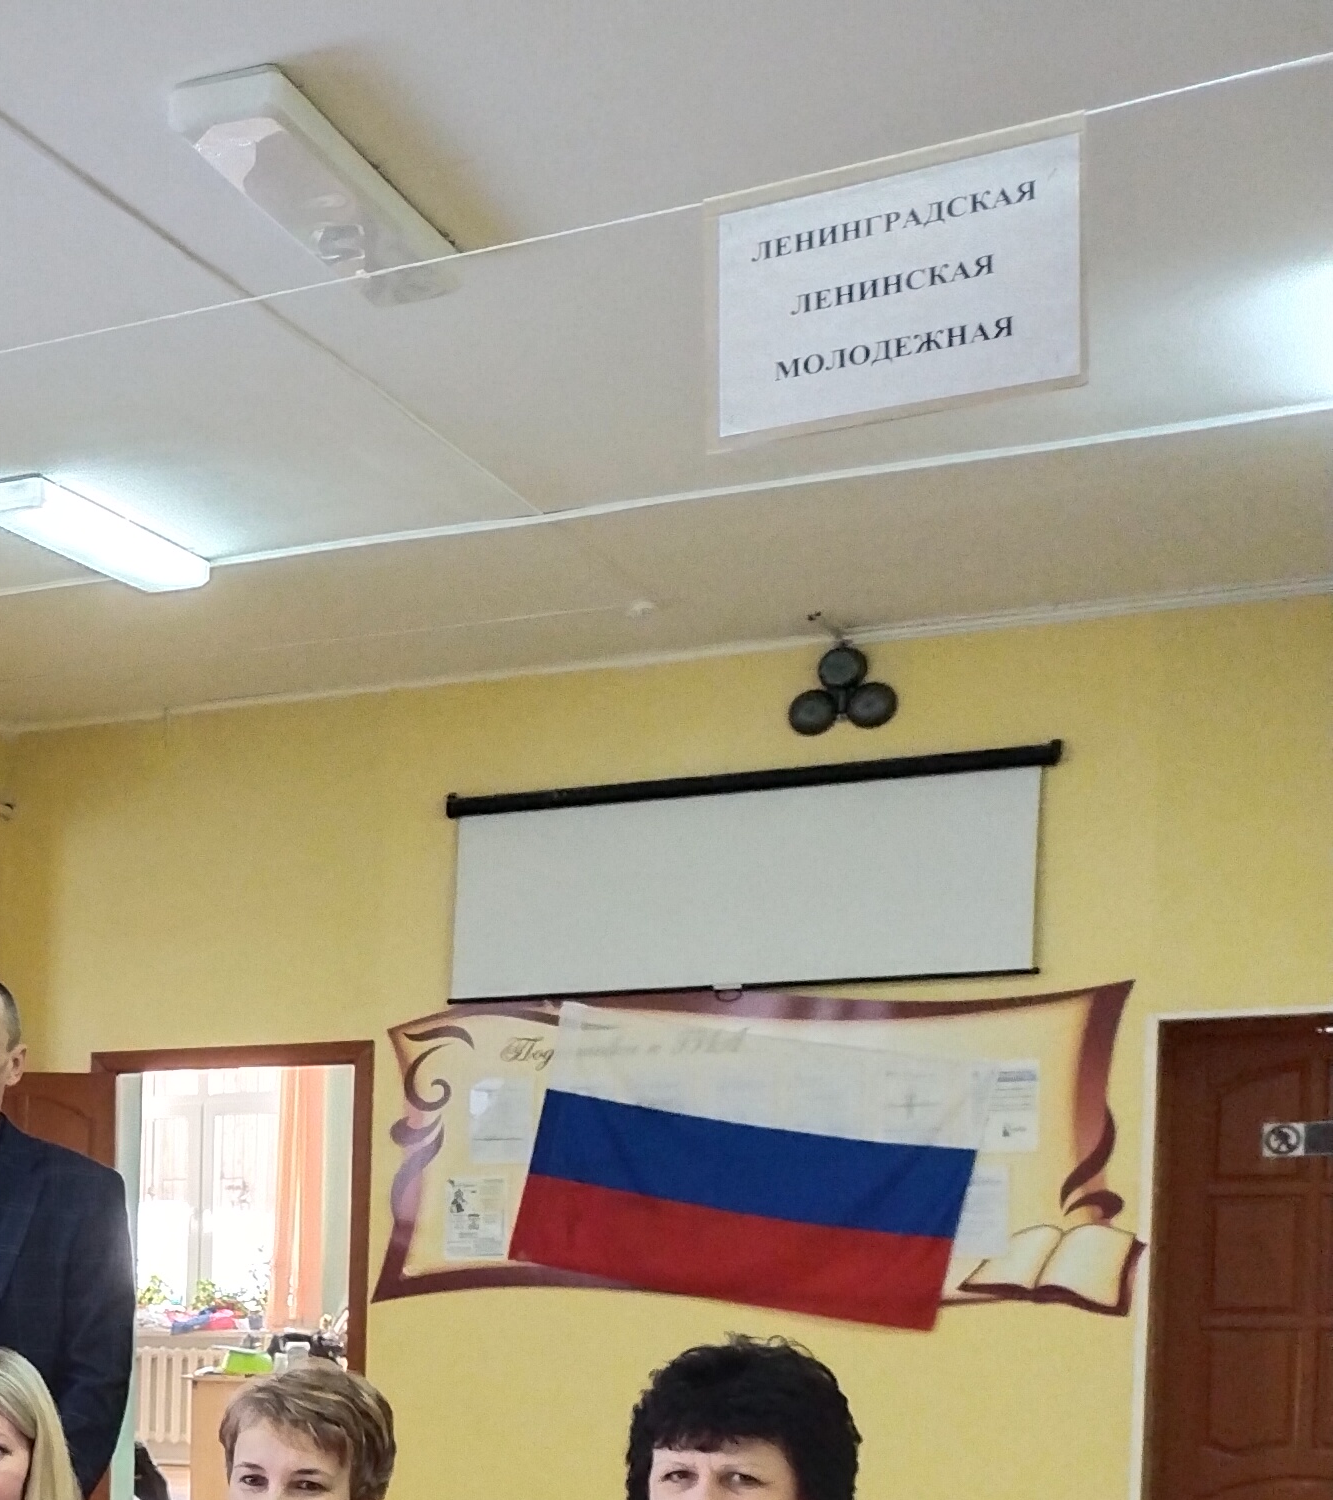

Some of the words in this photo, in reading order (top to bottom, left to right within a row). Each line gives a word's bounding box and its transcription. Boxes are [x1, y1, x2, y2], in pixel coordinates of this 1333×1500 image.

[750, 179, 1037, 263] ЛЕНИНГРАДСКАЯ
[790, 253, 995, 316] ЛЕНИНСКАЯ
[774, 315, 1014, 382] МОЛОДЕЖНАЯ
